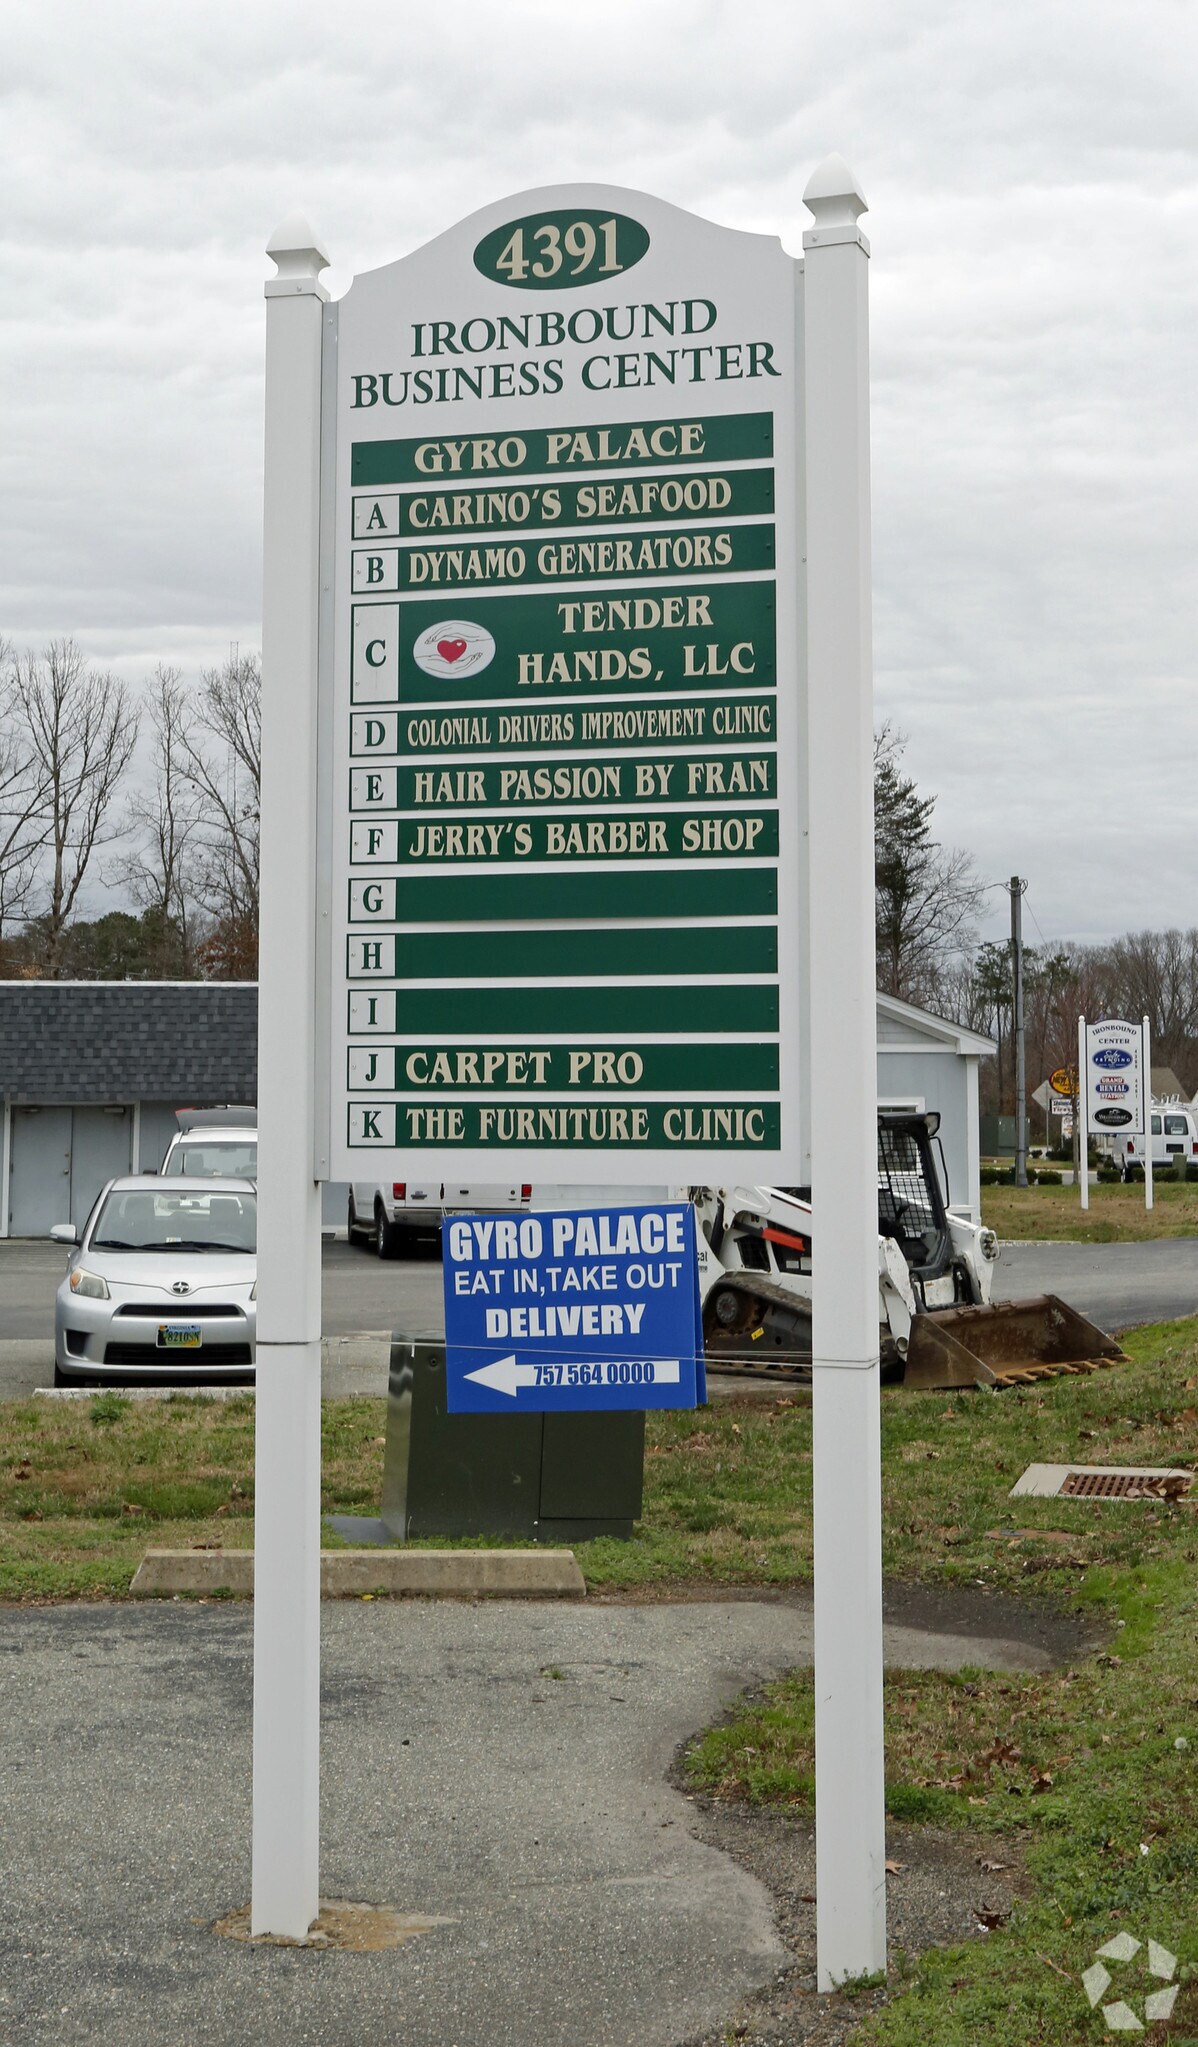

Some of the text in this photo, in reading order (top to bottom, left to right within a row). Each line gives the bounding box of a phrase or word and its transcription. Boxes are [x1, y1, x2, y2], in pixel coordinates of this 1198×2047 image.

[496, 218, 624, 281] 4391
[410, 298, 718, 358] IRONBOUND
[349, 341, 782, 409] BUSINESS CENTER
[413, 423, 707, 474] GYRO PALACE
[366, 477, 732, 530] A CARINO'S SEAFOOD
[366, 533, 733, 584] B DYNAMO GENERATORS
[557, 594, 714, 635] TENDER
[365, 640, 386, 668] C
[517, 641, 756, 686] HANDS, LLC
[364, 704, 772, 748] D COLONIAL DRIVERS IMPROVEMENT CLINIC
[365, 760, 770, 804] E HAIR PASSION BY FRAN
[366, 818, 765, 858] F JERRY'S BARBER SHOP
[362, 884, 384, 913] G
[361, 942, 383, 970] H
[367, 998, 379, 1026] I
[1092, 1024, 1137, 1036] IRONBOUND
[364, 1051, 644, 1085] J CARPET PRO
[361, 1108, 765, 1142] K THE FURNITURE CLINIC
[449, 1213, 685, 1262] GYRO PALACE
[454, 1269, 505, 1296] EAT
[626, 1262, 683, 1289] OUT
[485, 1303, 646, 1339] DELIVERY
[533, 1362, 655, 1386] 757 564 0000
